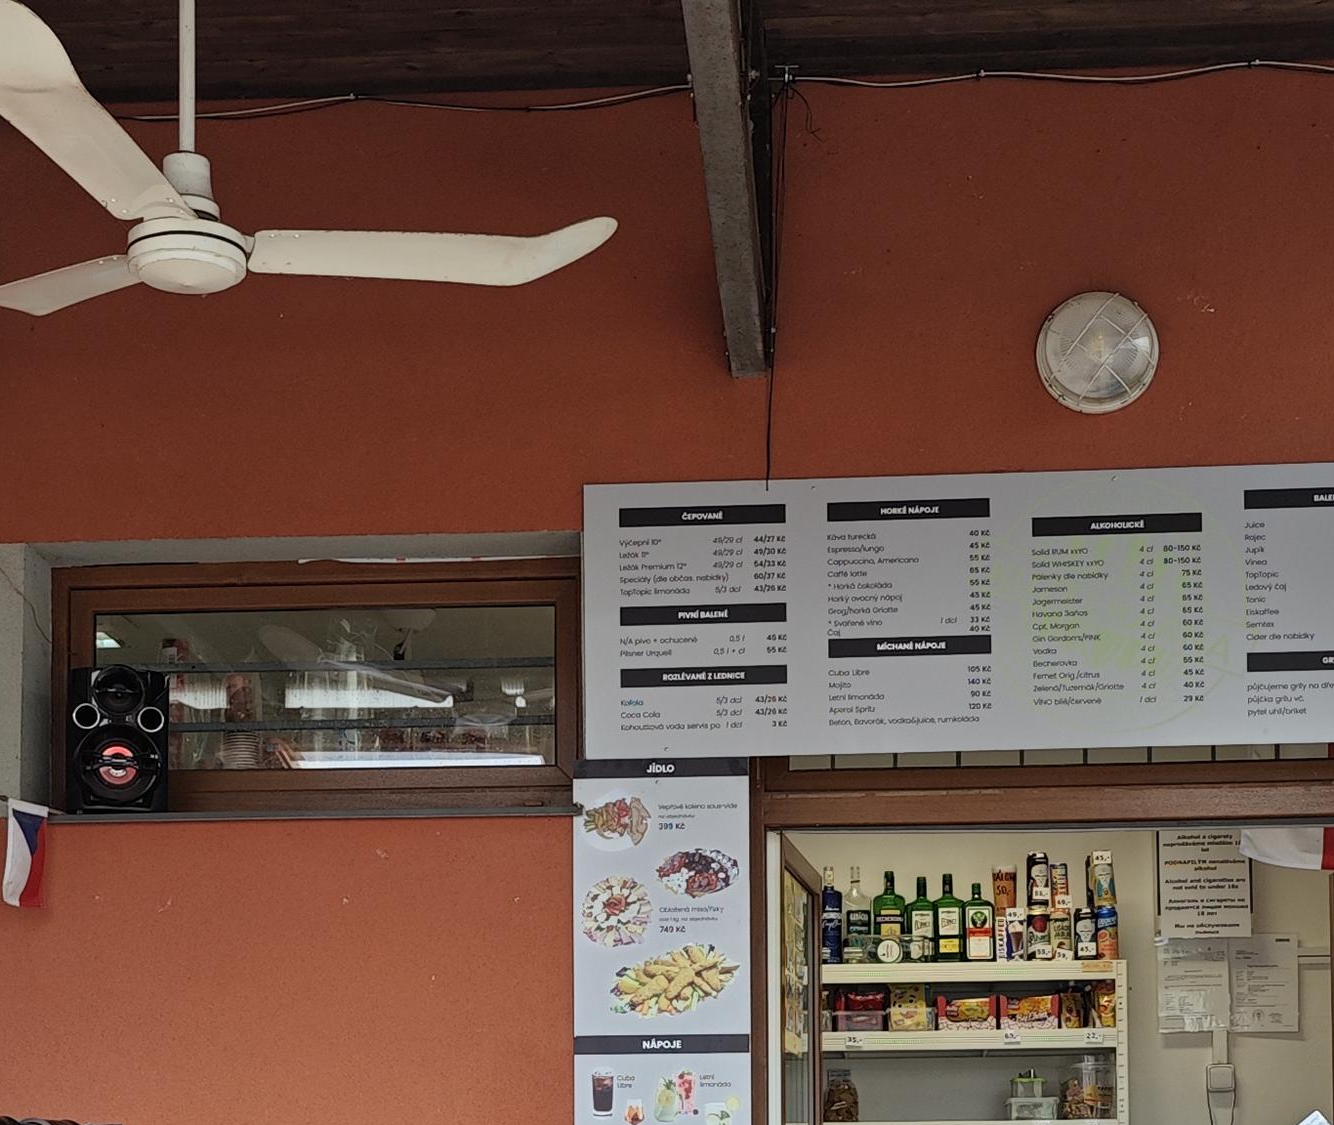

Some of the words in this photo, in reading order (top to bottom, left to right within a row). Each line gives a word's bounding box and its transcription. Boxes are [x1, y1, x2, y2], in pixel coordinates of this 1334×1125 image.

[682, 510, 723, 520] ČEPOVANÉ
[881, 506, 907, 515] HORKÉ
[908, 505, 939, 514] NÁPOJE
[1091, 520, 1144, 530] ALKOHOLICKÉ
[877, 641, 913, 650] MÍCHANÉ
[915, 640, 946, 650] NÁPOJE
[646, 762, 675, 774] JÍDLO
[676, 822, 685, 830] Kč
[642, 1038, 682, 1050] NÁPOJE
